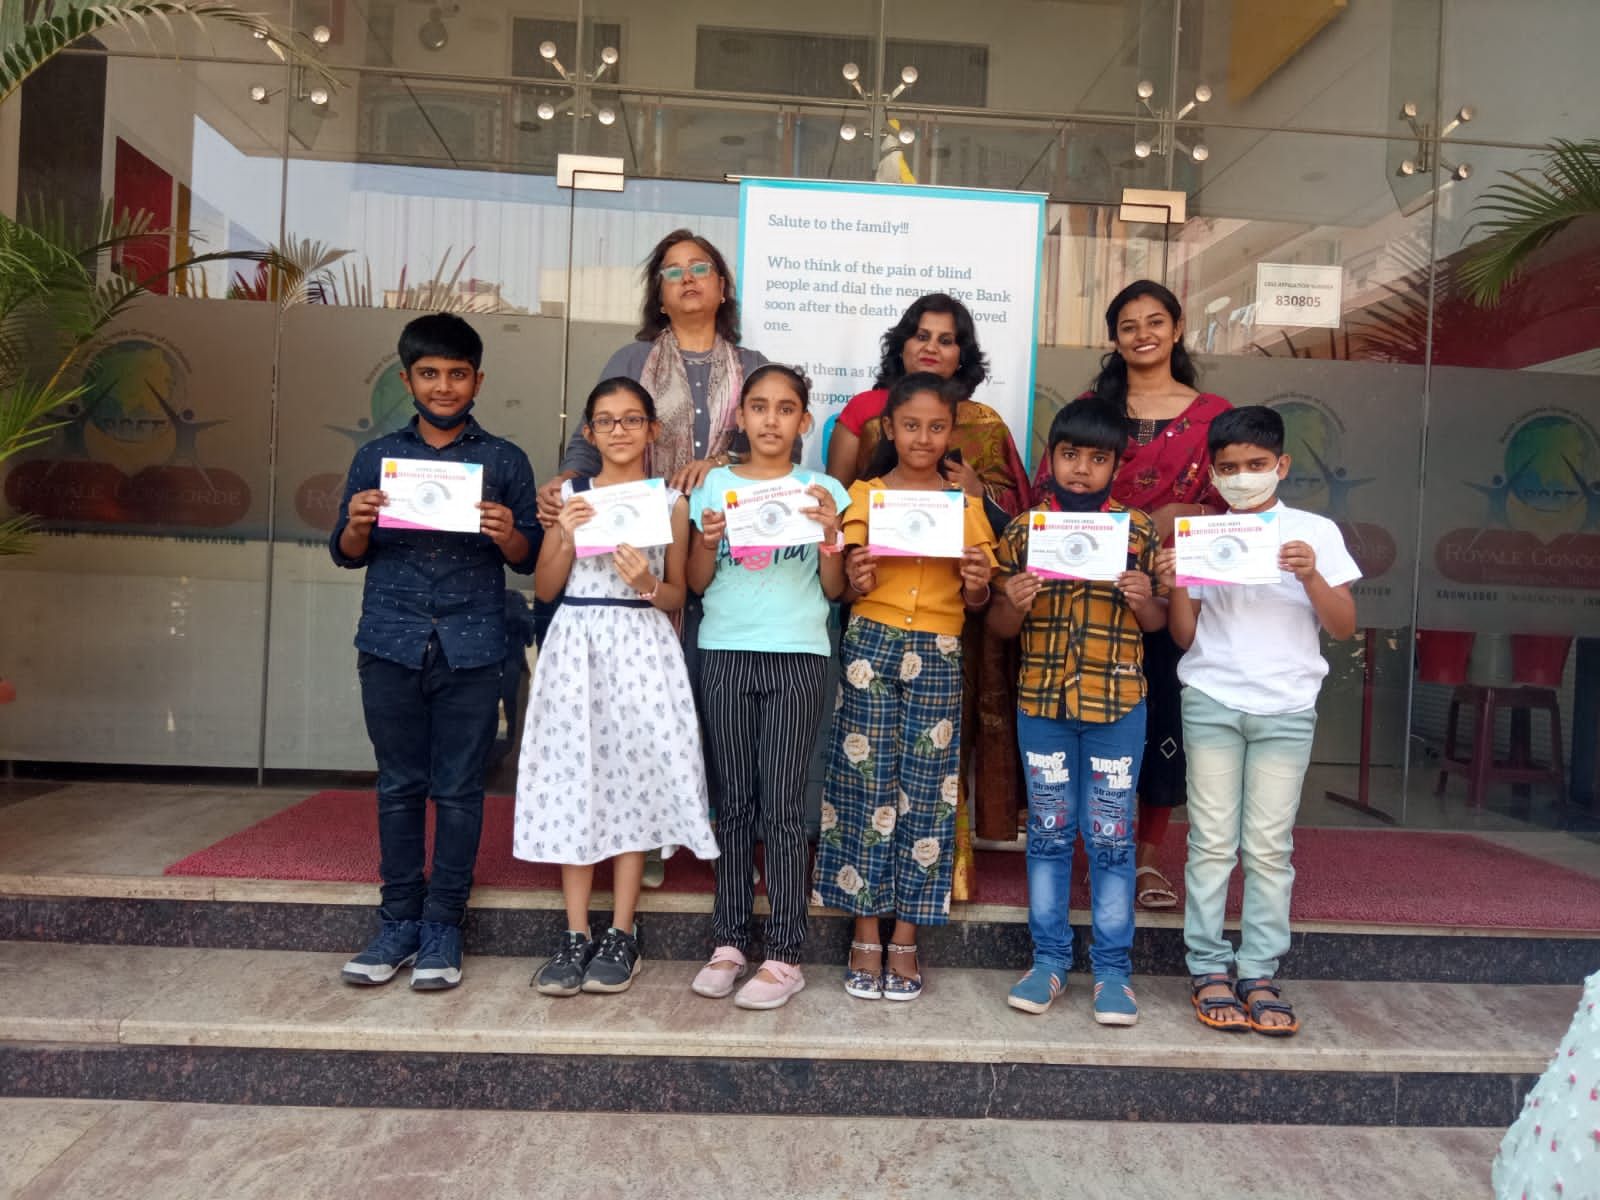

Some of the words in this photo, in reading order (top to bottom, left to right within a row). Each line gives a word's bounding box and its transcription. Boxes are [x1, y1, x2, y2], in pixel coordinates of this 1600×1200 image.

[768, 214, 811, 229] Salute
[814, 218, 827, 230] to
[831, 218, 853, 231] the
[856, 219, 910, 236] family!!!
[768, 255, 801, 270] Who
[804, 258, 841, 273] think
[845, 260, 860, 273] of
[862, 261, 885, 275] the
[887, 263, 916, 278] pain
[920, 265, 935, 278] of
[937, 265, 972, 280] blind
[766, 279, 810, 292] people
[814, 280, 839, 293] and
[842, 281, 866, 295] dial
[870, 283, 892, 296] the
[976, 288, 1011, 303] Bank
[765, 300, 795, 311] soon
[799, 300, 831, 313] after
[835, 301, 857, 315] the
[860, 303, 898, 317] death
[1276, 295, 1321, 308] 830805
[764, 320, 792, 332] one.
[813, 362, 847, 377] them
[850, 367, 864, 378] as
[808, 391, 855, 405] uppor
